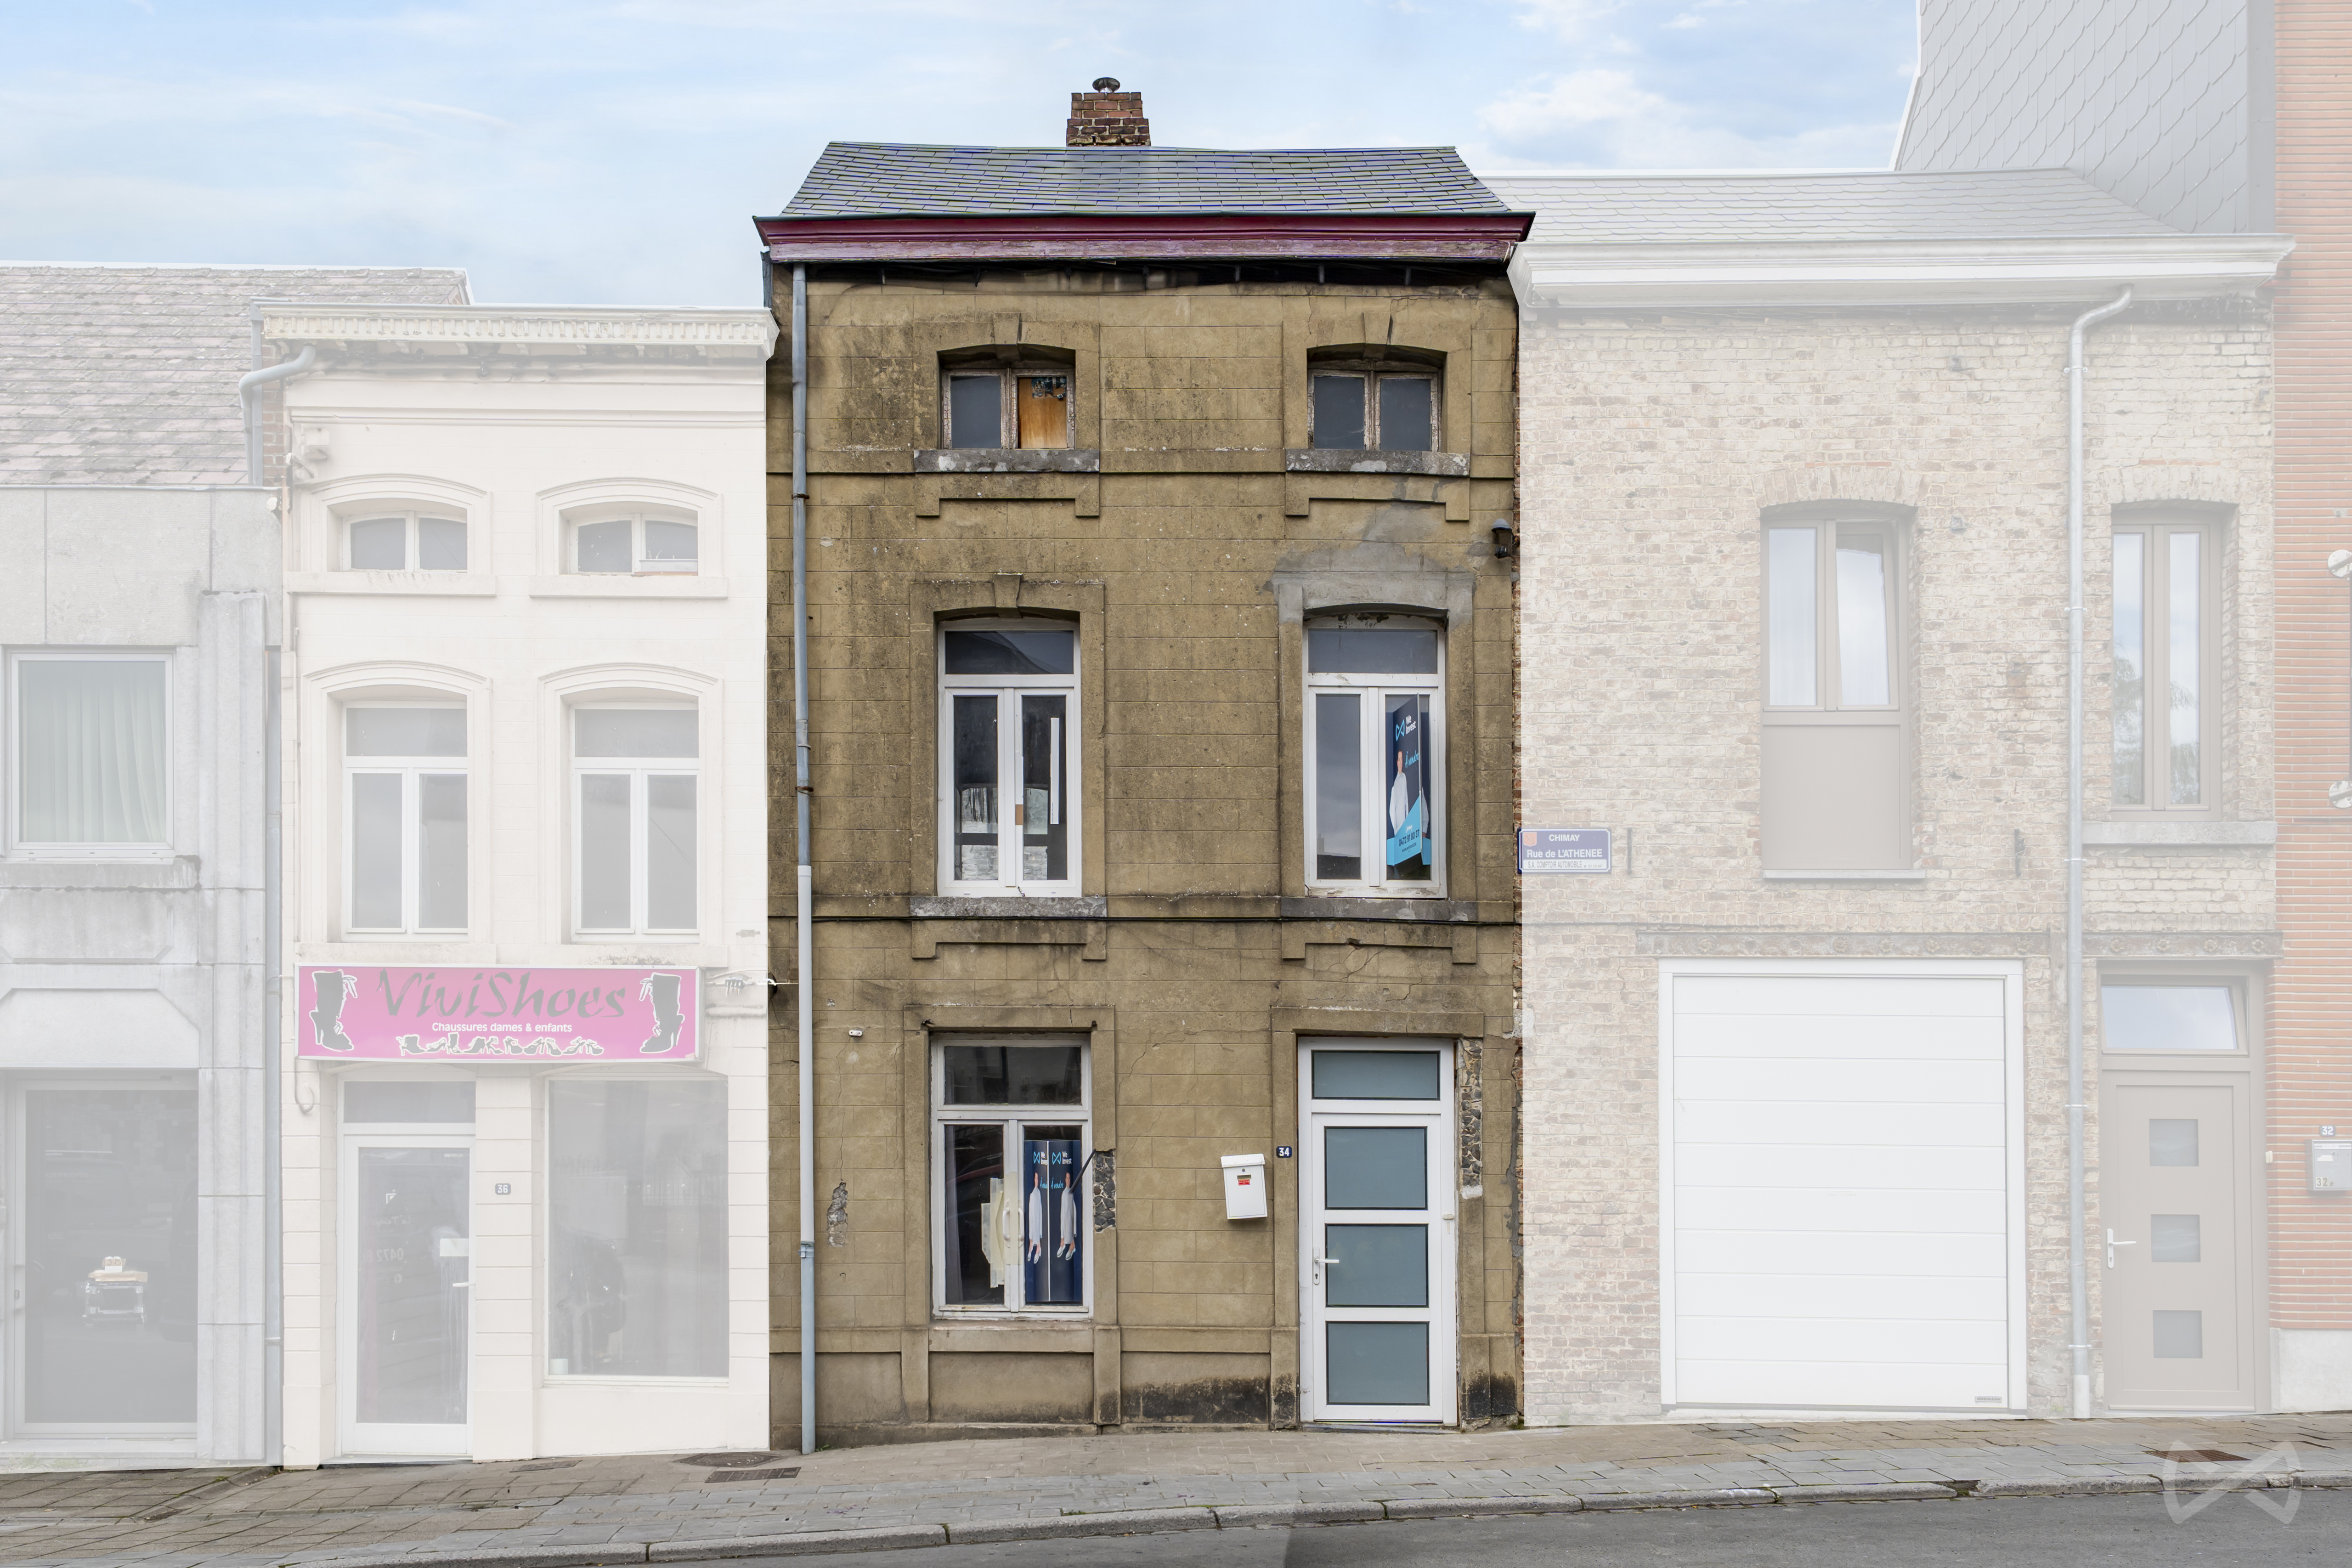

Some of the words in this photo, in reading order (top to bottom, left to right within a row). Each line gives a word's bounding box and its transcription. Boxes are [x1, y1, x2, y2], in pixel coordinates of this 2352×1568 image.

[1405, 714, 1412, 725] We
[1406, 720, 1416, 735] Invest
[1398, 835, 1407, 847] 0472
[1407, 833, 1411, 843] 91
[1411, 831, 1415, 840] 80
[1415, 829, 1419, 838] 37
[1527, 849, 1543, 858] Rue
[1545, 849, 1556, 858] de
[1558, 849, 1603, 857] L'ATHENEE
[432, 1022, 487, 1031] Chaussures
[490, 1022, 523, 1031] dames
[526, 1023, 533, 1032] &
[535, 1022, 572, 1032] enfants
[2322, 1126, 2333, 1135] 32
[1279, 1148, 1289, 1156] 34
[497, 1184, 509, 1194] 36
[1054, 1179, 1063, 1189] vendre
